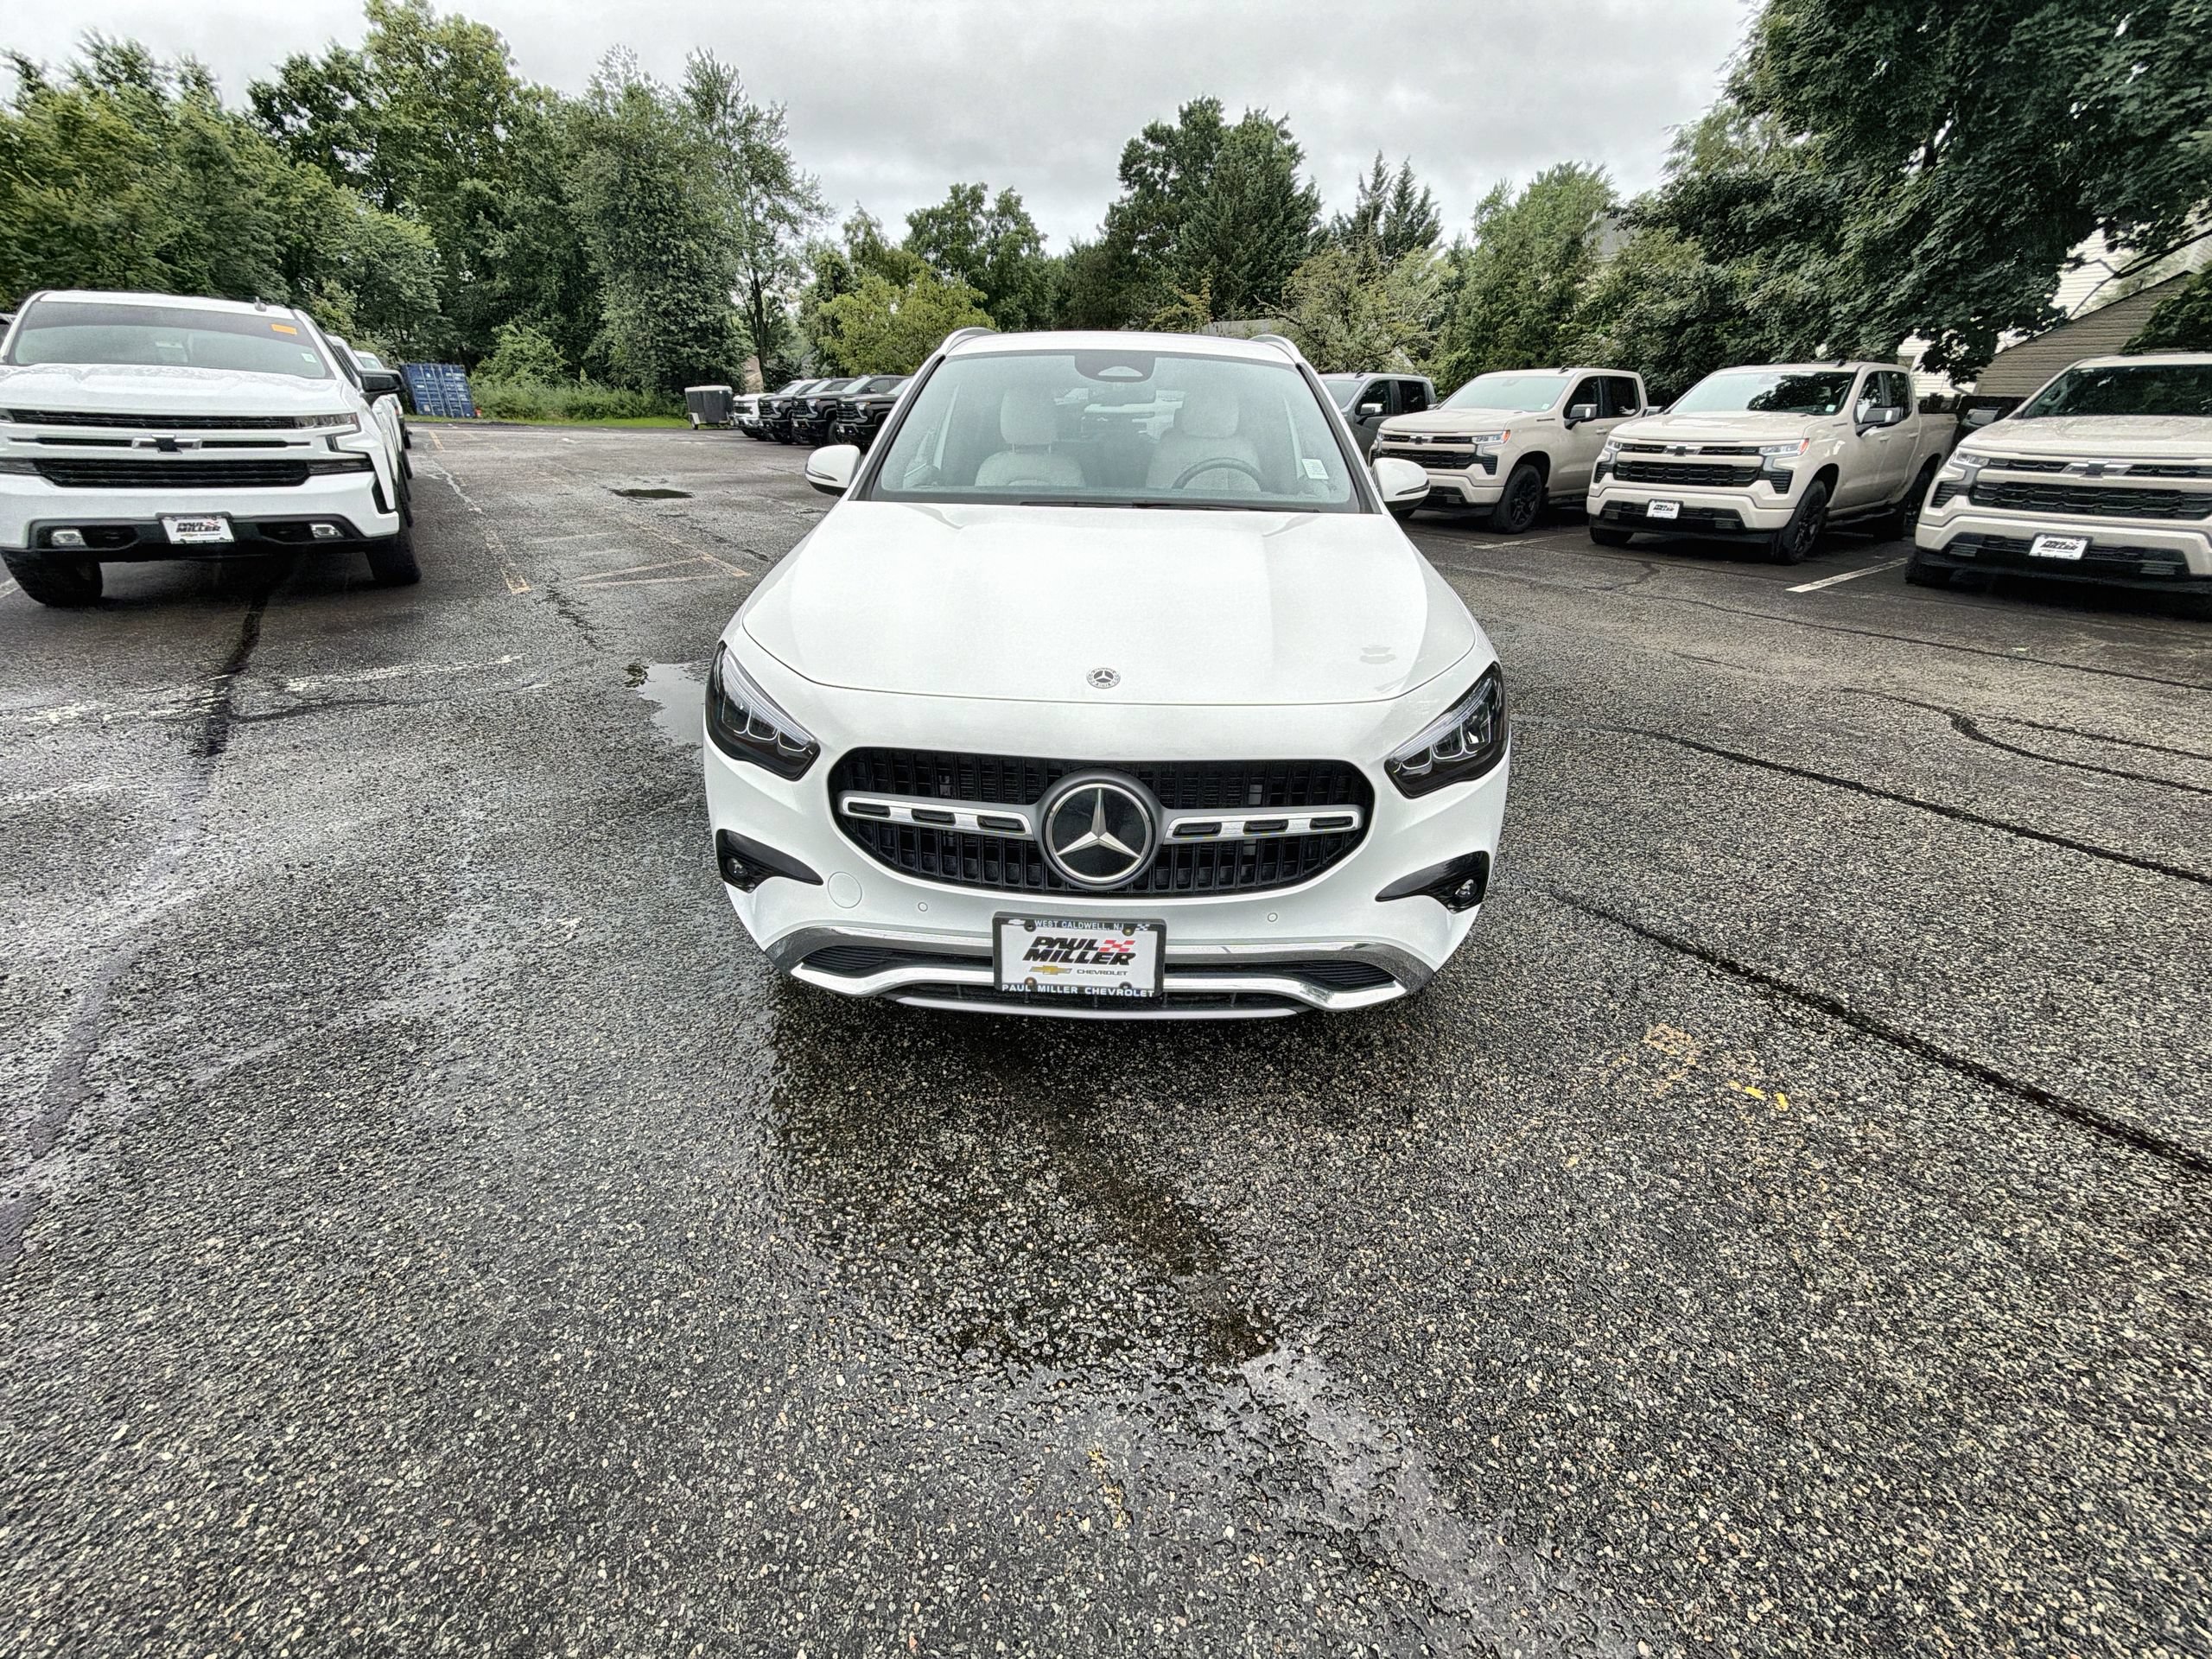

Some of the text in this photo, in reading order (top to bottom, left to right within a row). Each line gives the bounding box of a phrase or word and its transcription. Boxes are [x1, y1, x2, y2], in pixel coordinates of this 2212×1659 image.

[1034, 919, 1058, 928] WEST
[1031, 936, 1100, 950] PAUL
[1022, 948, 1136, 965] MILLER
[1001, 983, 1155, 998] PAUL MILLER CHEVROLET
